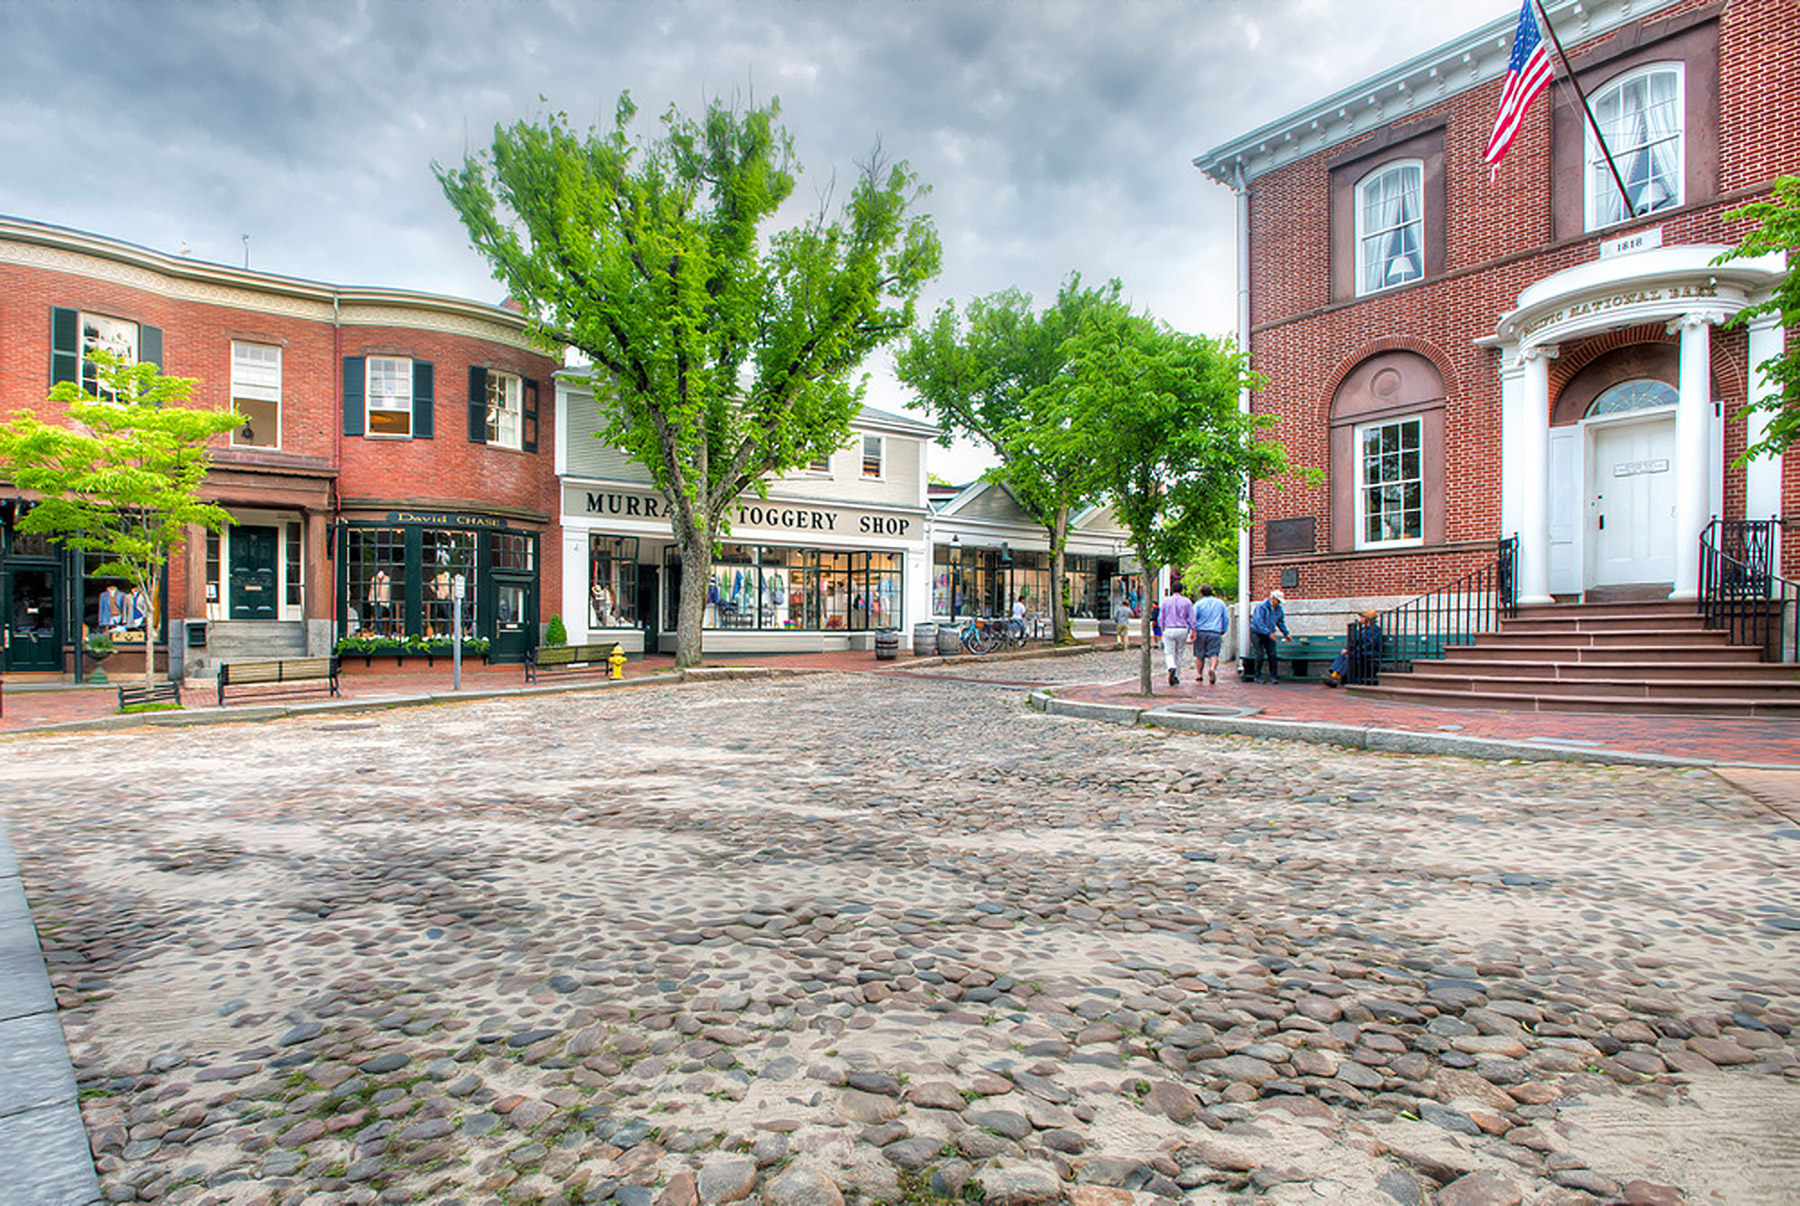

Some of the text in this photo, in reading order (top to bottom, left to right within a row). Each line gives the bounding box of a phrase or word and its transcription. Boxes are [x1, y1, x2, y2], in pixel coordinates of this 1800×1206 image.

[1617, 237, 1642, 251] 1818
[1568, 289, 1661, 319] NATIONAL
[398, 512, 500, 527] David CHASE
[736, 506, 838, 531] TOGGERY
[859, 516, 910, 536] SHOP
